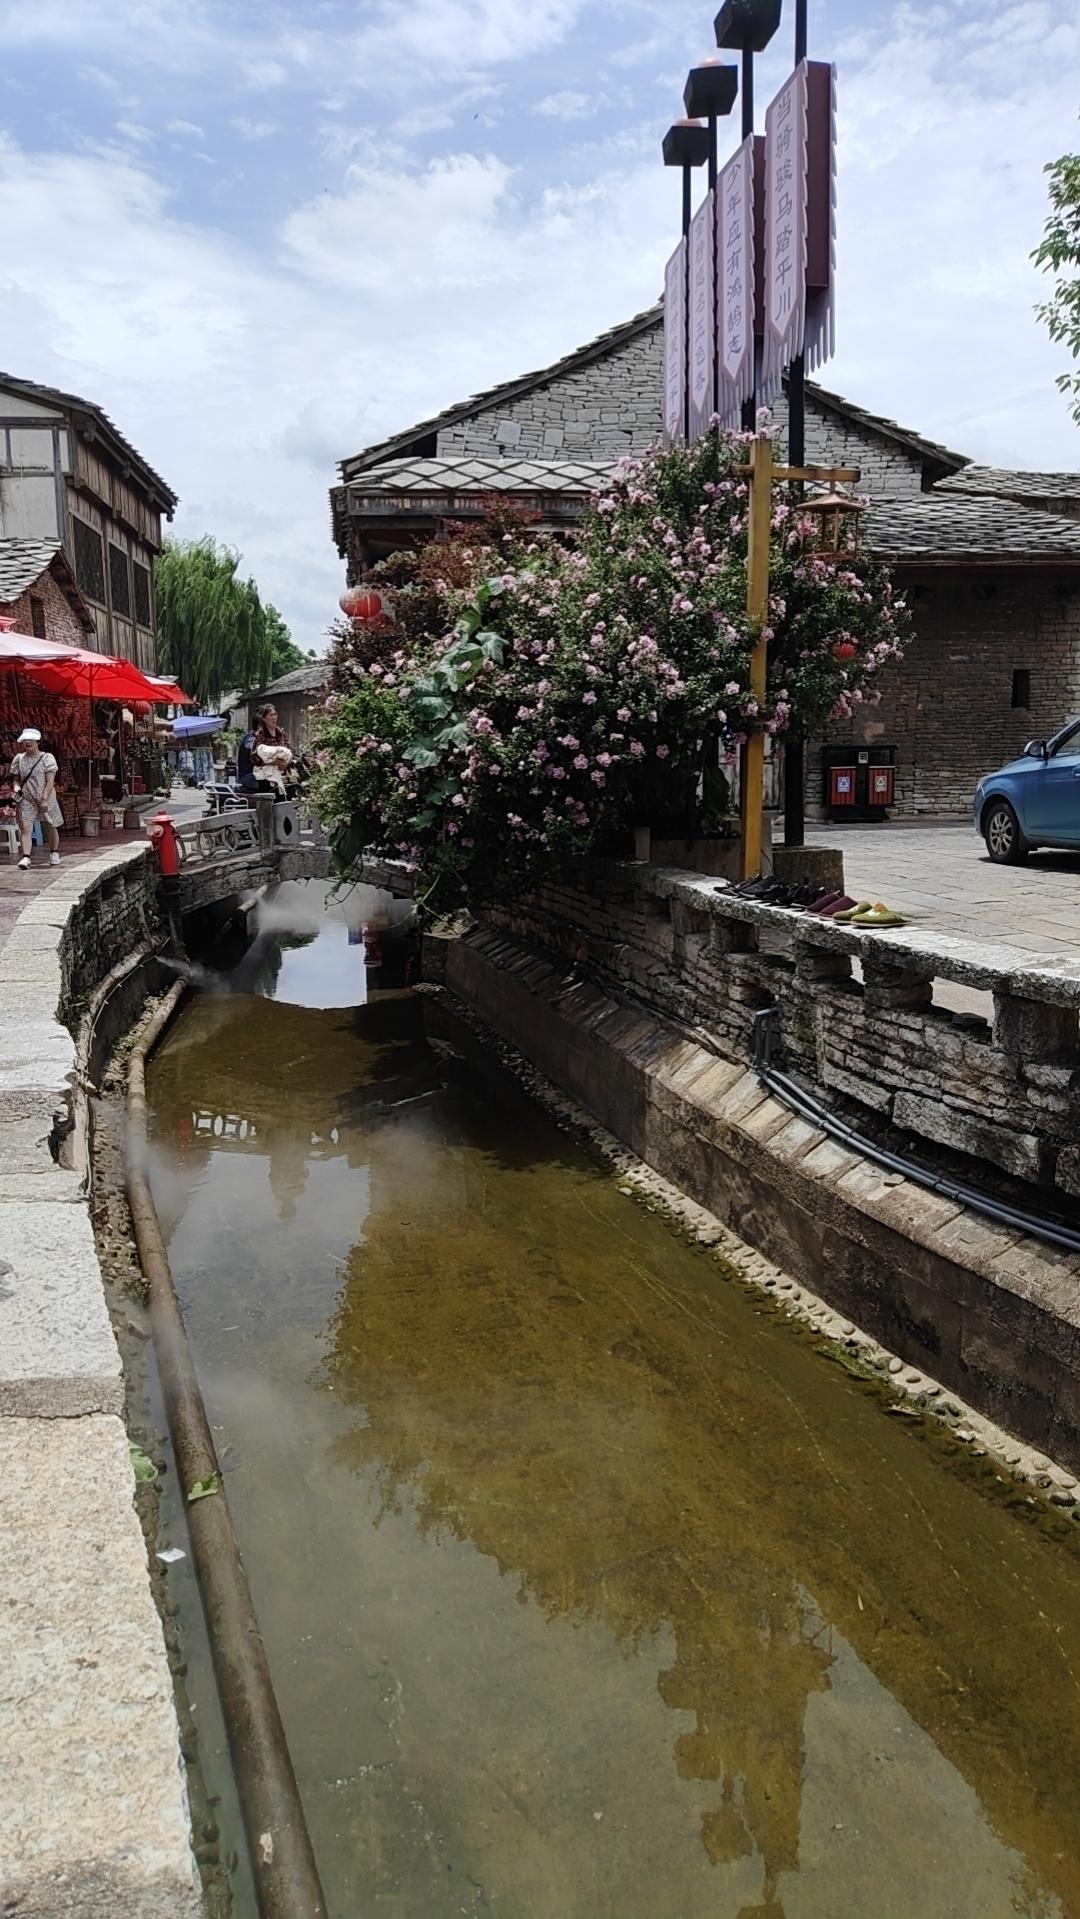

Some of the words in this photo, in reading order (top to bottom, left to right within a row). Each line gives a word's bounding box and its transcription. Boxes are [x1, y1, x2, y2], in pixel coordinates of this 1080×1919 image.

[726, 162, 742, 362] 少年应有鸿鹄志
[775, 90, 793, 322] 当骑骏马踏平川
